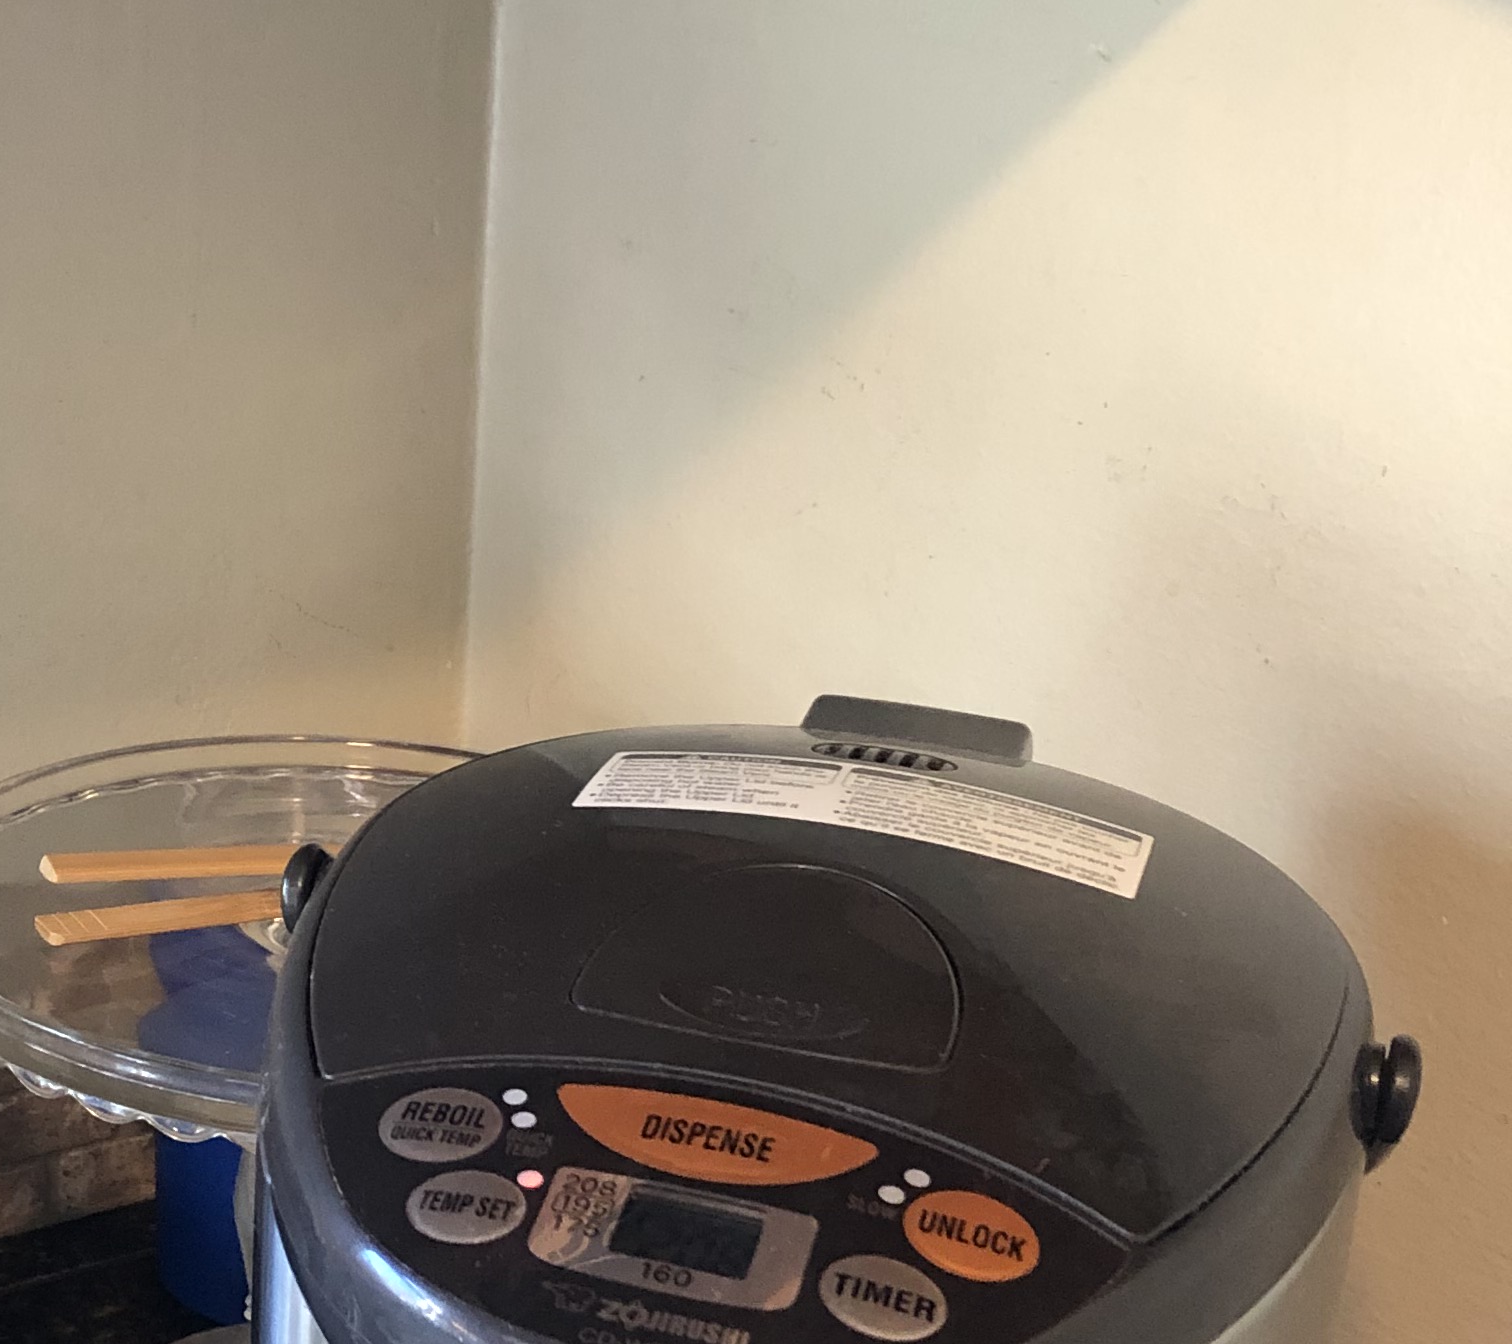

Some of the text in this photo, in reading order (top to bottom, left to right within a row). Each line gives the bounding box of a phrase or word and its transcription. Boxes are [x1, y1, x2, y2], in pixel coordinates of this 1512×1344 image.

[400, 1100, 489, 1131] REBOIL
[390, 1125, 482, 1149] QUICK TEMP
[640, 1114, 776, 1163] DISPENSE
[563, 1172, 618, 1197] 208
[419, 1188, 518, 1223] TEMP SET
[916, 1207, 1026, 1263] UNLOCK
[640, 1261, 694, 1288] 160
[832, 1271, 939, 1323] TIMER
